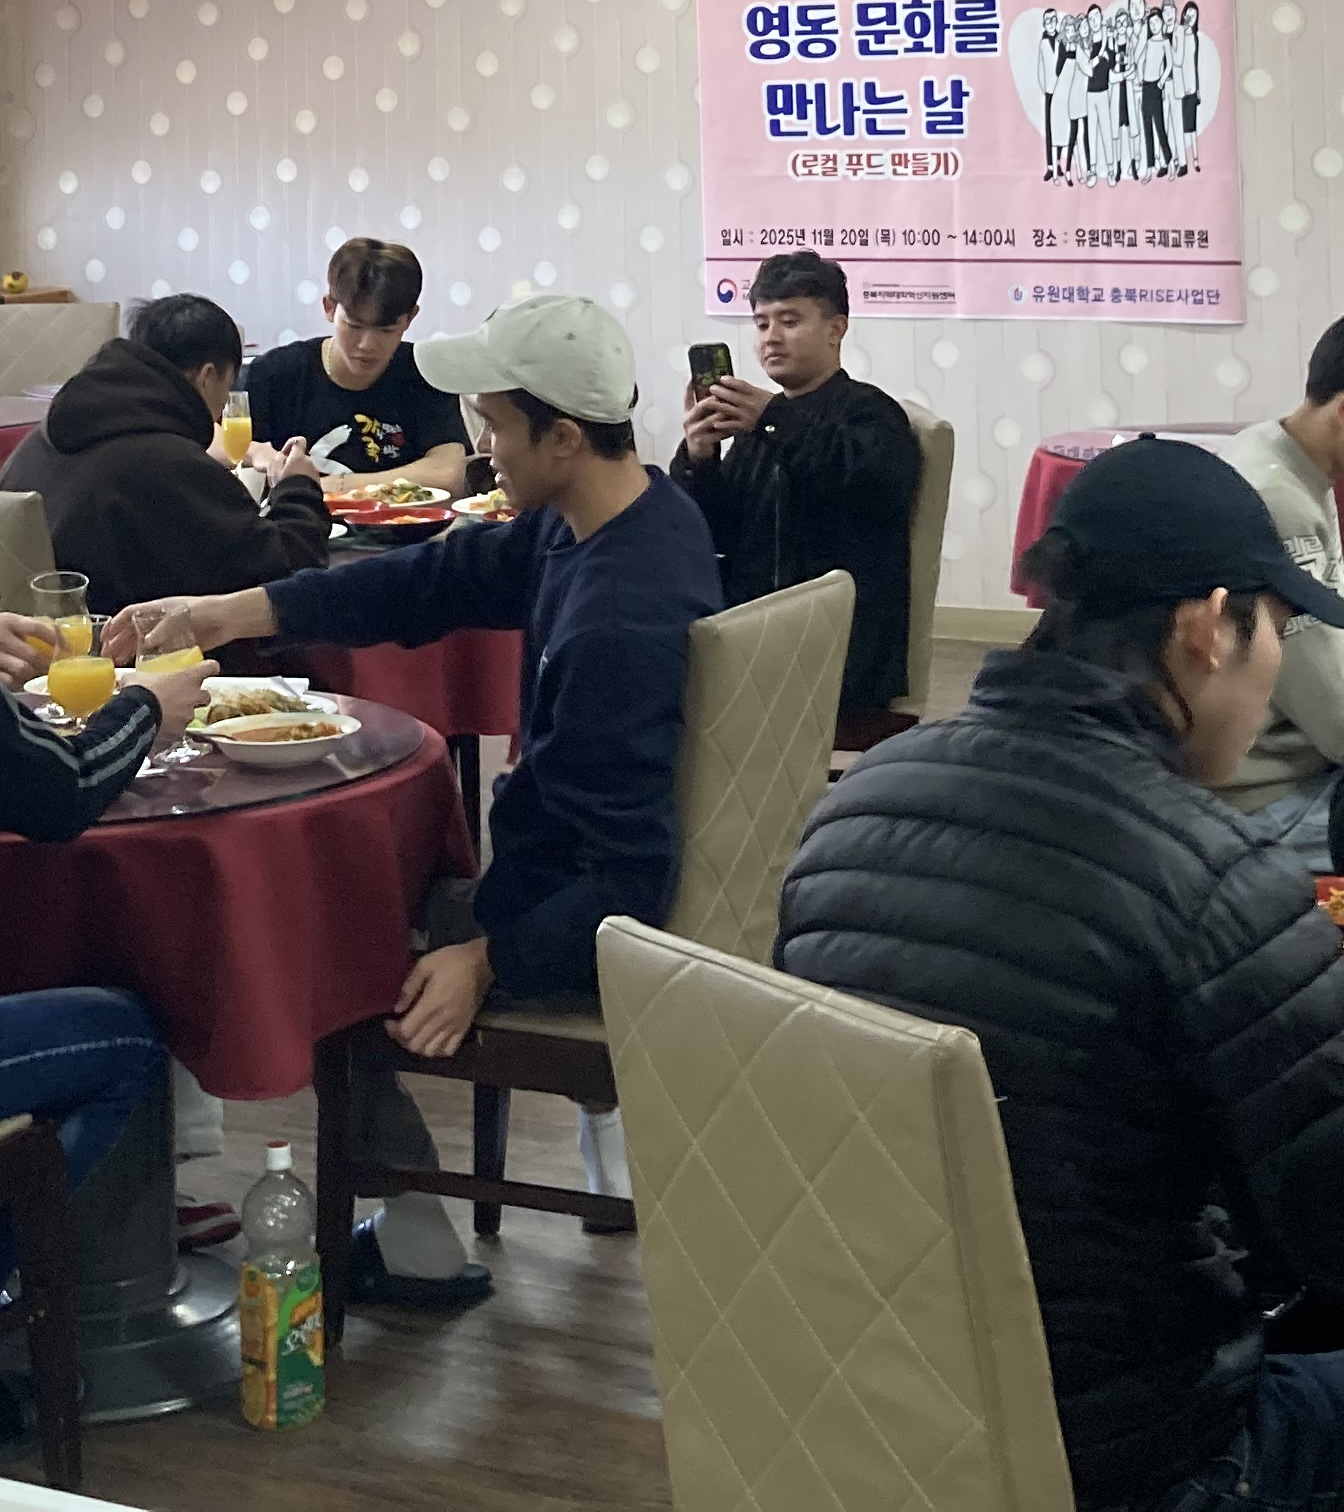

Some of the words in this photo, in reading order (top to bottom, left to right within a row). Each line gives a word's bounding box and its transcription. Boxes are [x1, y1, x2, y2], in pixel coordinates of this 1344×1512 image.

[746, 3, 839, 60] 영동
[766, 81, 908, 137] 만나는
[923, 79, 970, 134] 날
[791, 152, 838, 177] (로컬
[845, 152, 885, 177] 푸드
[891, 151, 960, 177] 만들기)
[721, 228, 744, 246] 일시
[760, 228, 806, 246] 2025년
[812, 228, 835, 246] 11월
[840, 228, 869, 246] 20일
[875, 228, 896, 247] (목)
[902, 228, 941, 246] 10:00
[963, 228, 1016, 247] 14:00시
[1033, 228, 1057, 248] 장소
[1075, 228, 1138, 248] 유원대학교
[1145, 229, 1209, 248] 국제교류원
[1032, 285, 1105, 303] 유원대학교
[1110, 288, 1221, 305] 충북RISE사업단
